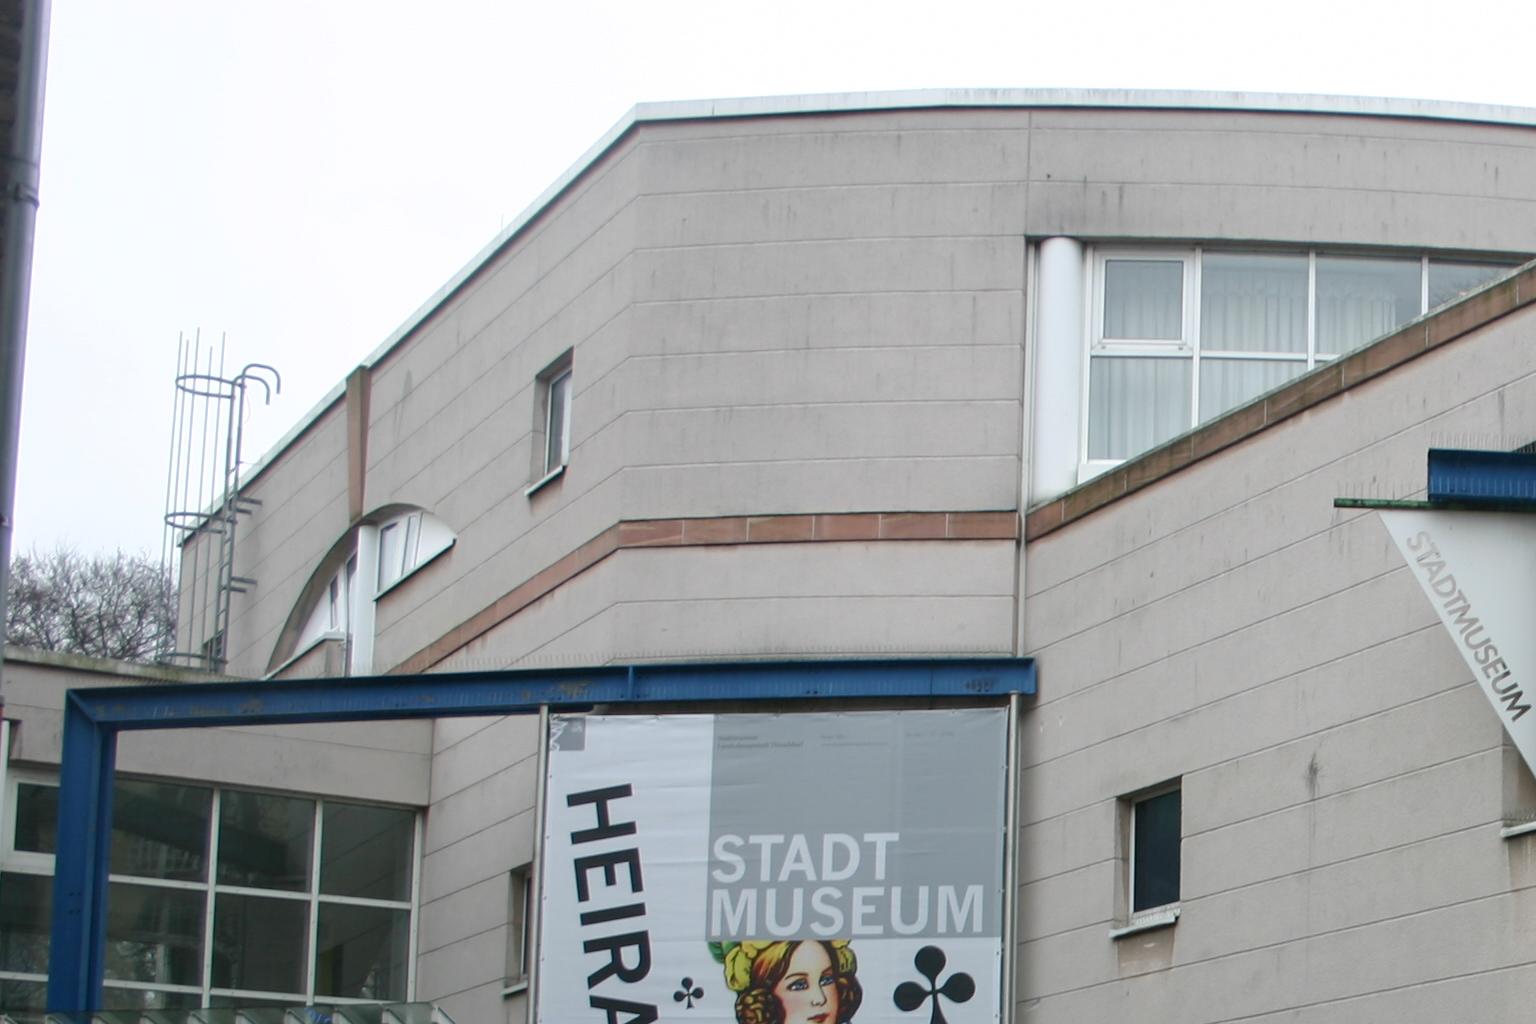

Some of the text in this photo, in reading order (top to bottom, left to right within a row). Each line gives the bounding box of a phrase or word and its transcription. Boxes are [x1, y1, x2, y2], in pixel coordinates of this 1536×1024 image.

[1406, 530, 1532, 722] STADTMUSEUM
[711, 832, 899, 882] STADT
[709, 884, 984, 936] MUSEUM
